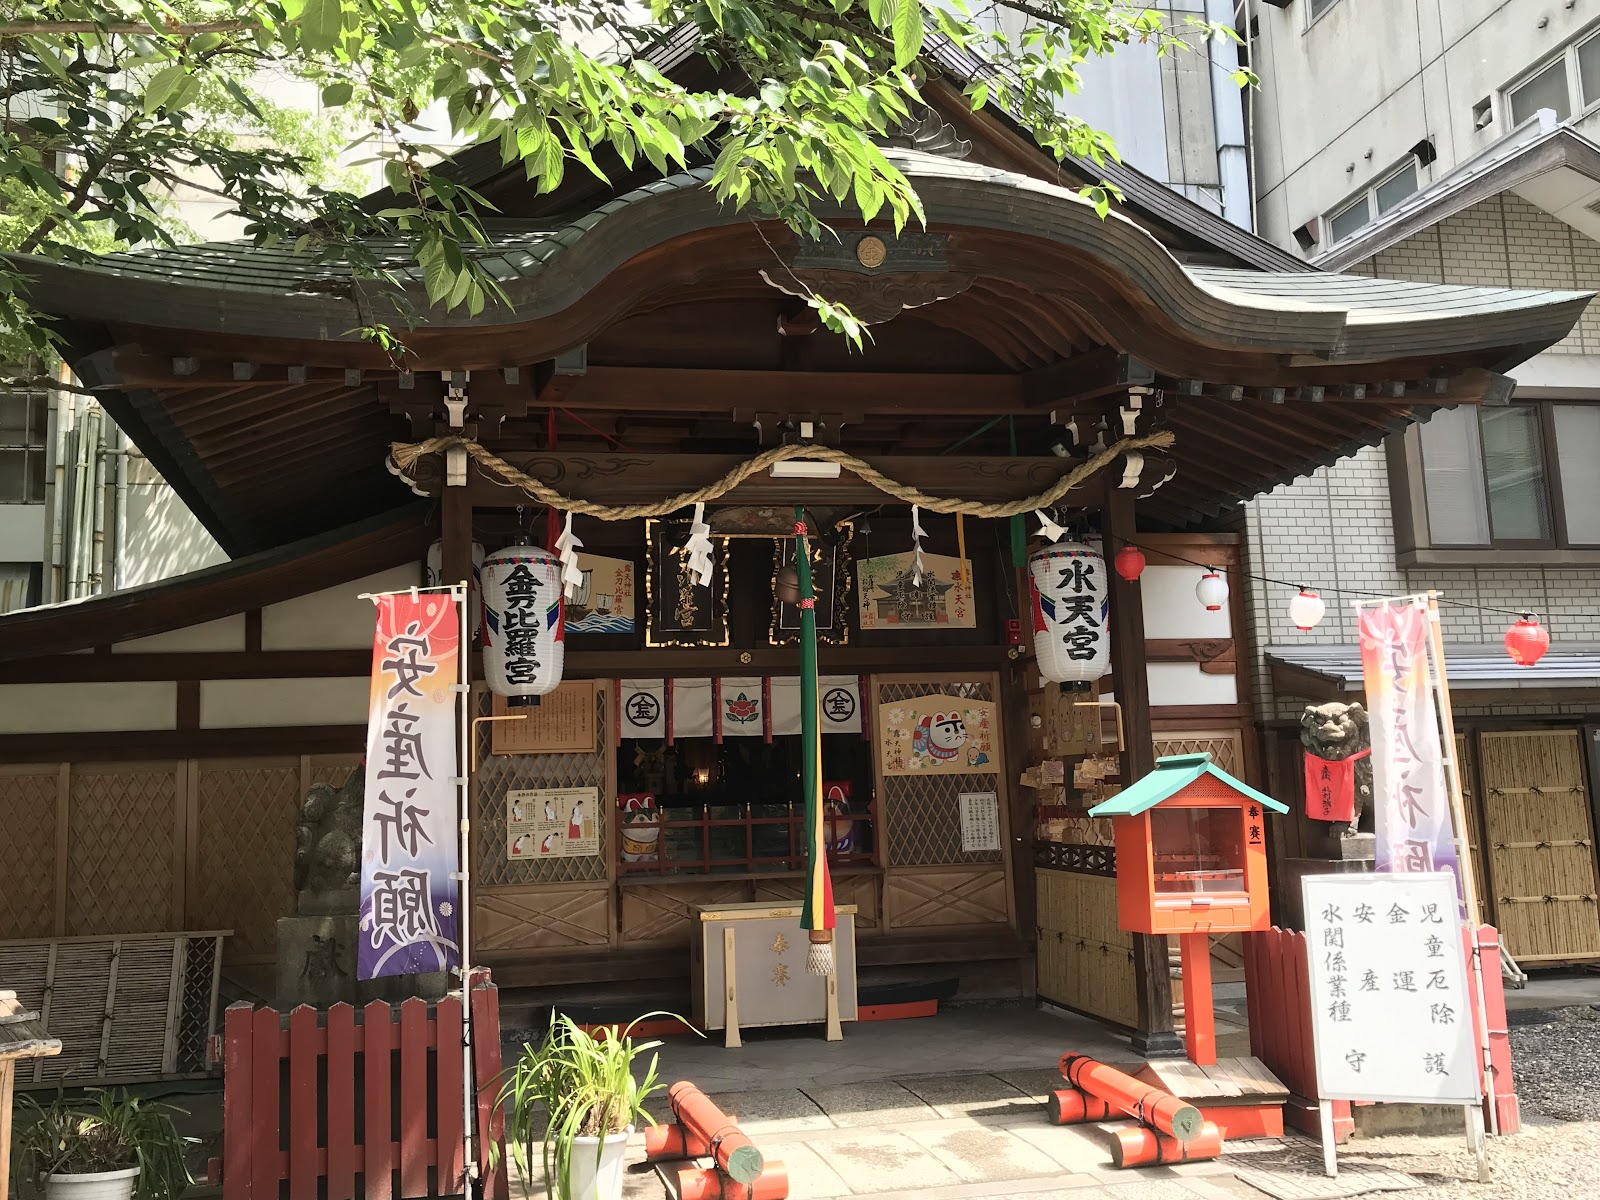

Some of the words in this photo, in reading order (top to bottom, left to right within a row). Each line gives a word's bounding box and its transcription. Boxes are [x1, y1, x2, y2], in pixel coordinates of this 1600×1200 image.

[500, 564, 544, 686] 金刀比羅宮
[615, 568, 624, 615] 金刀比羅宮
[954, 581, 965, 619] 水天宮
[1056, 559, 1100, 661] 水天宮
[885, 738, 893, 770] 水天宮
[979, 706, 992, 753] 安産祈願
[1248, 804, 1260, 840] 奉賽
[770, 931, 790, 987] 奉賽
[1321, 902, 1353, 1023] 水関係業種
[1352, 902, 1380, 992] 安産
[1385, 902, 1418, 993] 金運
[1420, 902, 1455, 1025] 児童厄除
